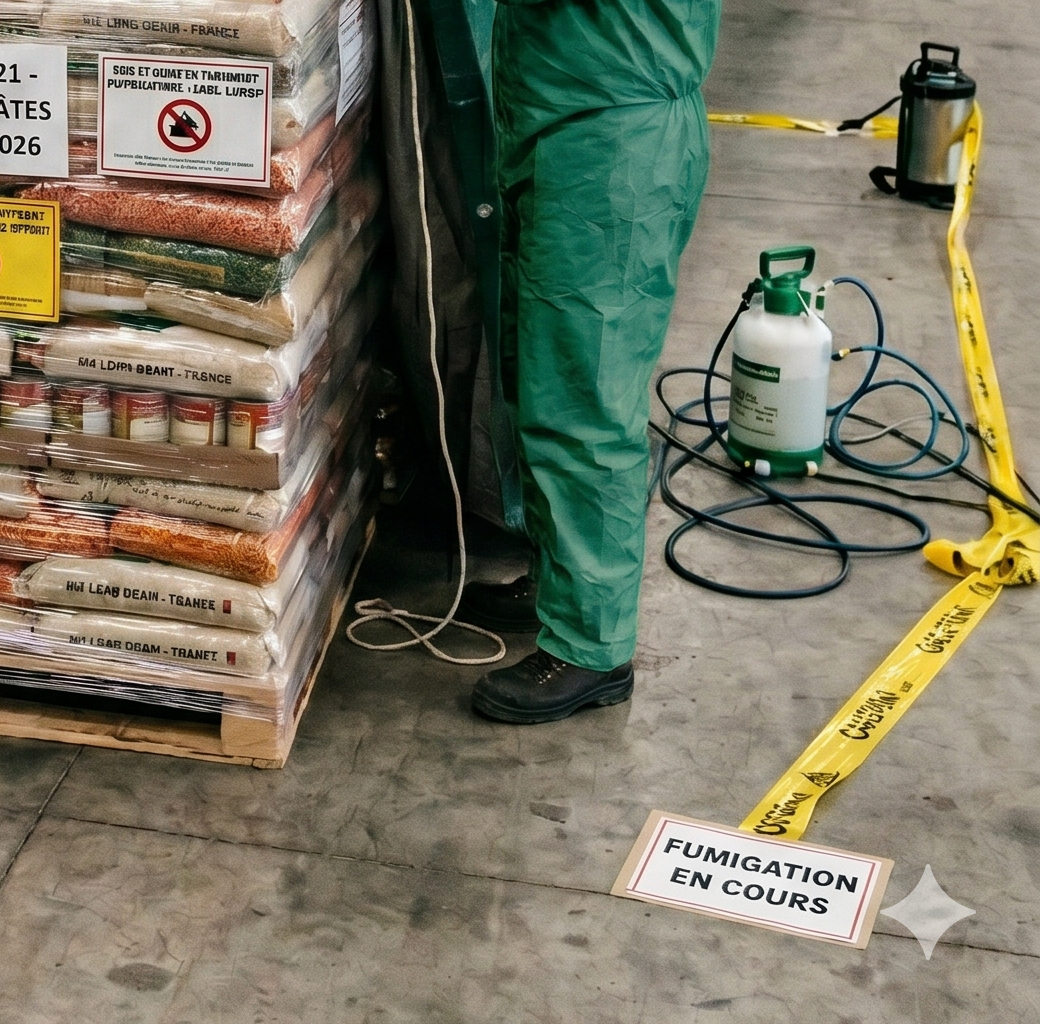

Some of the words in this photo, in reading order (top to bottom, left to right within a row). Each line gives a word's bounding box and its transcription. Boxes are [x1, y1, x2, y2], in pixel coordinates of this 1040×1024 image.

[138, 66, 151, 77] ET
[663, 837, 858, 893] FUMIGATION
[670, 866, 713, 890] EN
[721, 879, 830, 915] COURS
